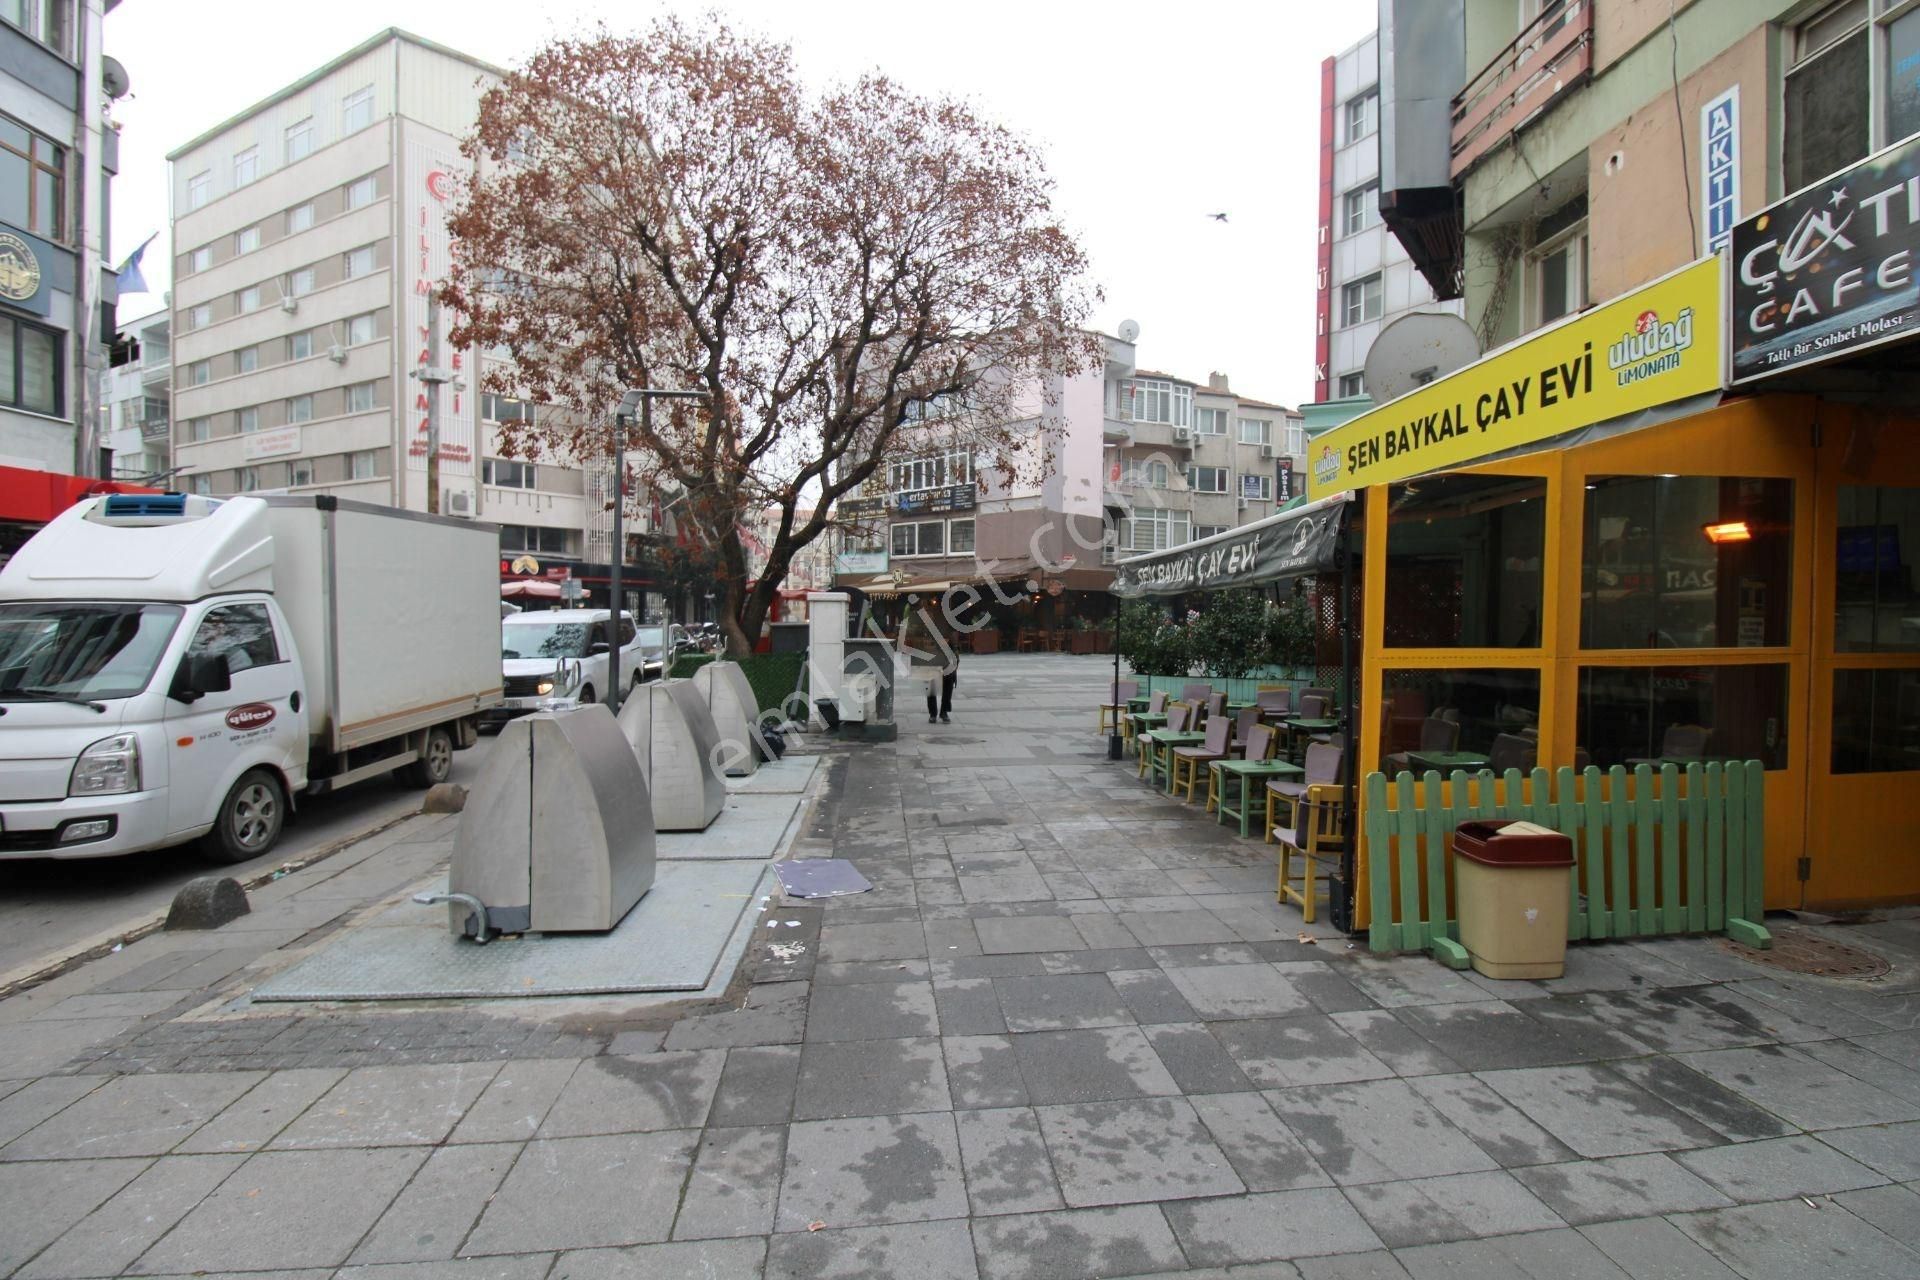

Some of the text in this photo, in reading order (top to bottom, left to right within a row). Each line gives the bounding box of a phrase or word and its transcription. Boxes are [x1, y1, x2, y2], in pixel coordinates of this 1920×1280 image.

[1314, 225, 1329, 383] TÜİK
[1749, 249, 1912, 334] CAFE
[1608, 306, 1693, 371] uludağ
[1793, 341, 1811, 358] Bir
[1814, 327, 1857, 353] Sohbet
[1860, 314, 1903, 336] Molası
[1617, 351, 1681, 387] LİMONATA
[1347, 341, 1594, 475] ŞEN BAYKAL ÇAY EVİ
[1197, 549, 1226, 585] ÇAY
